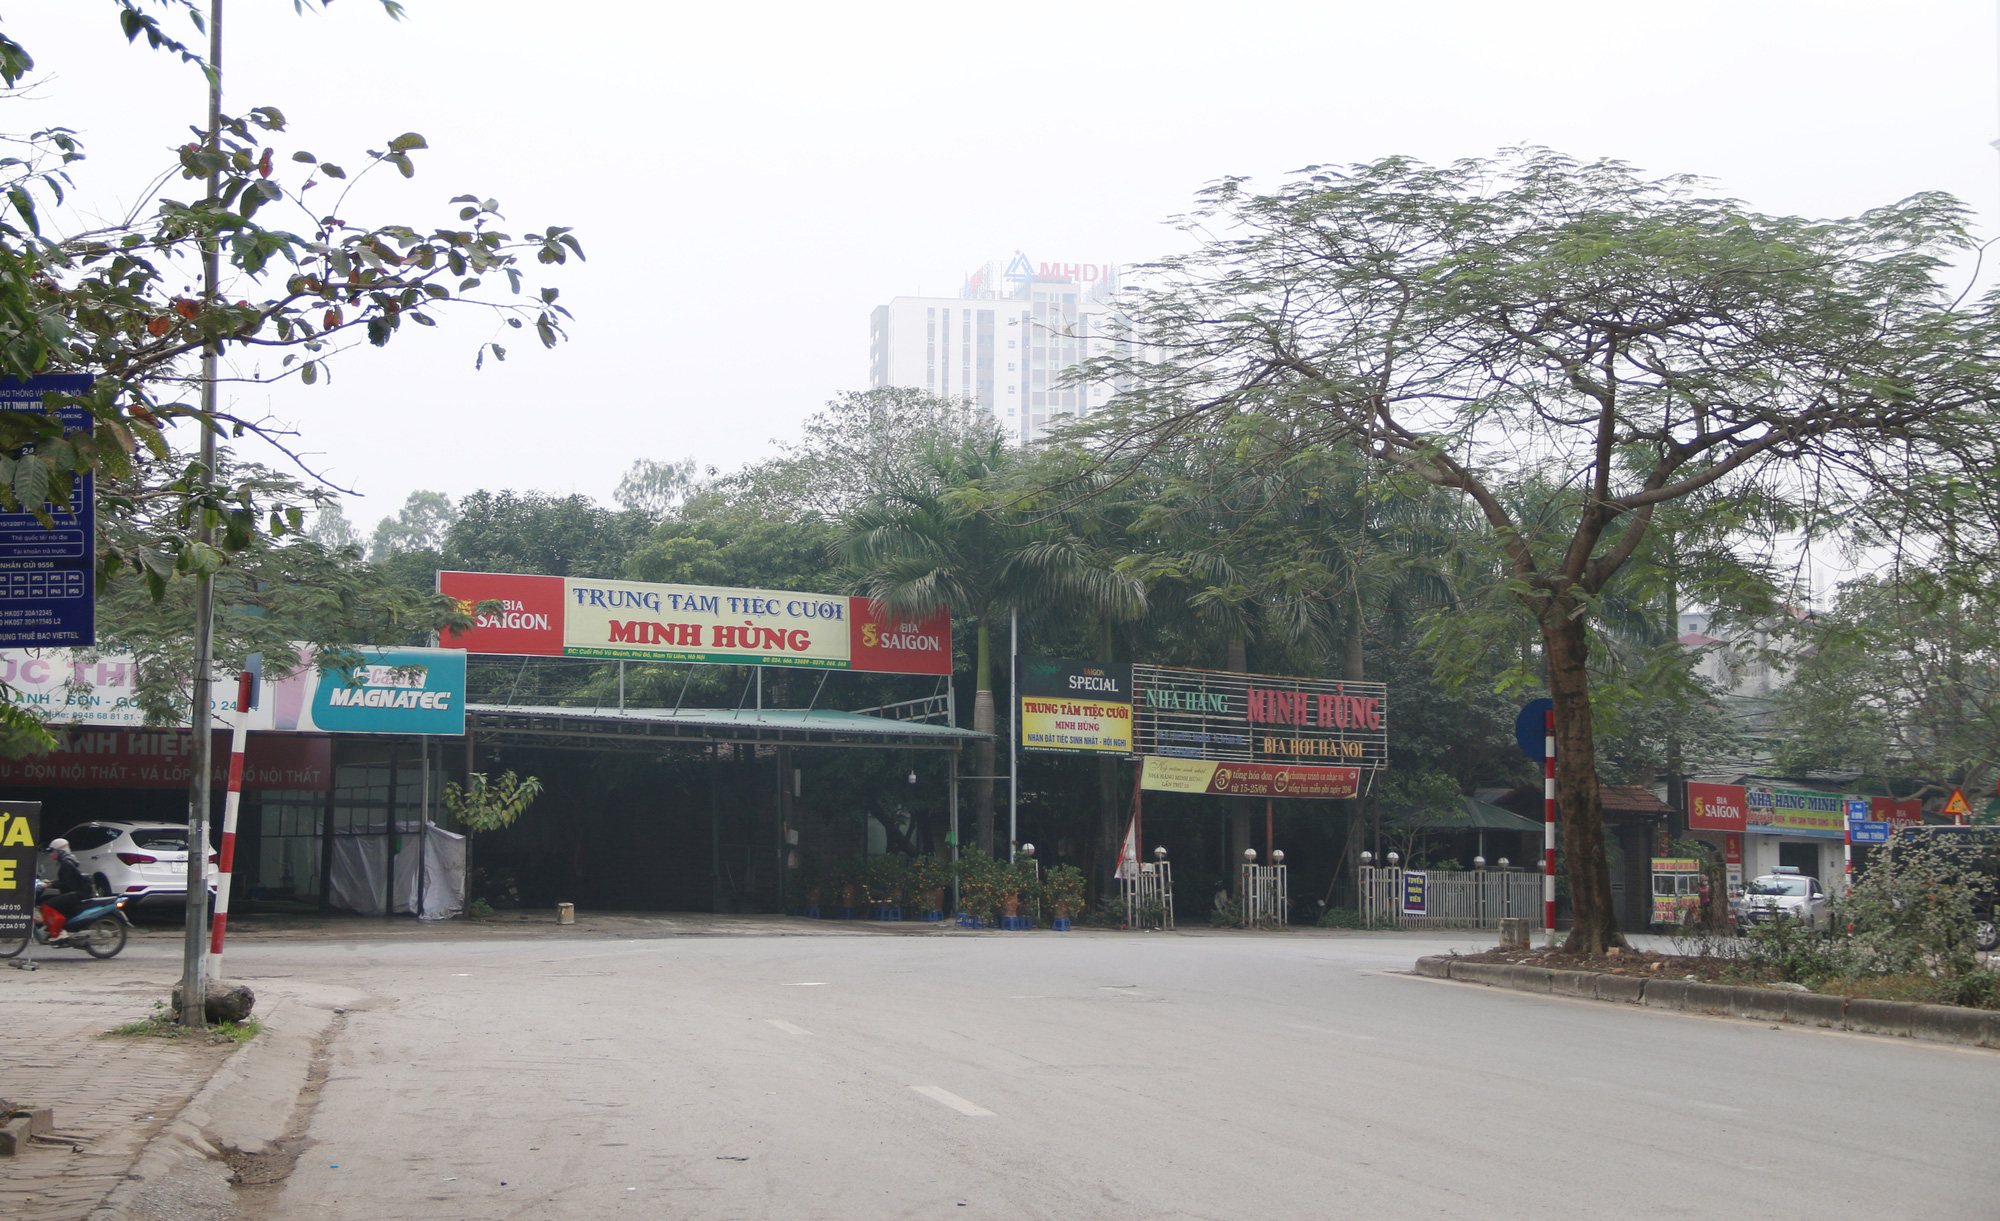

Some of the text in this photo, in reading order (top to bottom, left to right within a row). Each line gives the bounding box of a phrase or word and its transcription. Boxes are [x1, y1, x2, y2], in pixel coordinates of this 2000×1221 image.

[1040, 257, 1108, 282] MHDI
[12, 388, 34, 398] THÔNG
[12, 401, 29, 410] TNHH
[30, 401, 44, 409] MTV
[503, 600, 524, 611] BIA
[573, 587, 661, 615] TRUNG
[667, 592, 719, 617] TÂM
[726, 596, 781, 619] TIỆC
[24, 609, 53, 617] 30A12345
[53, 617, 61, 625] L2
[477, 612, 549, 631] SAIGON
[901, 623, 919, 633] BIA
[36, 632, 51, 640] BAO
[52, 631, 79, 639] VIETTEL
[608, 619, 811, 652] MINH HÙNG
[881, 632, 939, 651] SAIGON
[1083, 667, 1105, 676] SAIGON
[1069, 675, 1119, 692] SPECIAL
[329, 687, 451, 711] MAGNATEC
[1145, 683, 1229, 713] NHÀ HÀNG
[1024, 702, 1059, 714] TRUNG
[1060, 702, 1081, 716] TÂM
[1083, 703, 1105, 720] TIỆC
[1246, 684, 1381, 731] MINH HÙNG
[72, 711, 94, 720] 0948
[96, 712, 108, 720] 68
[1055, 720, 1100, 732] MINH HÙNG
[1069, 735, 1083, 745] SINH
[1263, 738, 1286, 754] BIA
[1319, 737, 1338, 757] HÀ
[24, 764, 56, 780] DỌN
[61, 762, 86, 780] NỘI
[90, 761, 128, 779] THẤT
[140, 763, 159, 780] VÁ
[163, 761, 192, 781] LỐP
[209, 765, 233, 782] ÁN
[260, 766, 283, 785] NỘI
[286, 764, 320, 783] THẤT
[1232, 767, 1247, 781] tổng
[1247, 769, 1260, 780] hóa
[1239, 783, 1268, 794] 15-25/06
[1716, 796, 1727, 805] BIA
[1808, 795, 1837, 812] MINH
[1705, 804, 1740, 818] SAIGON
